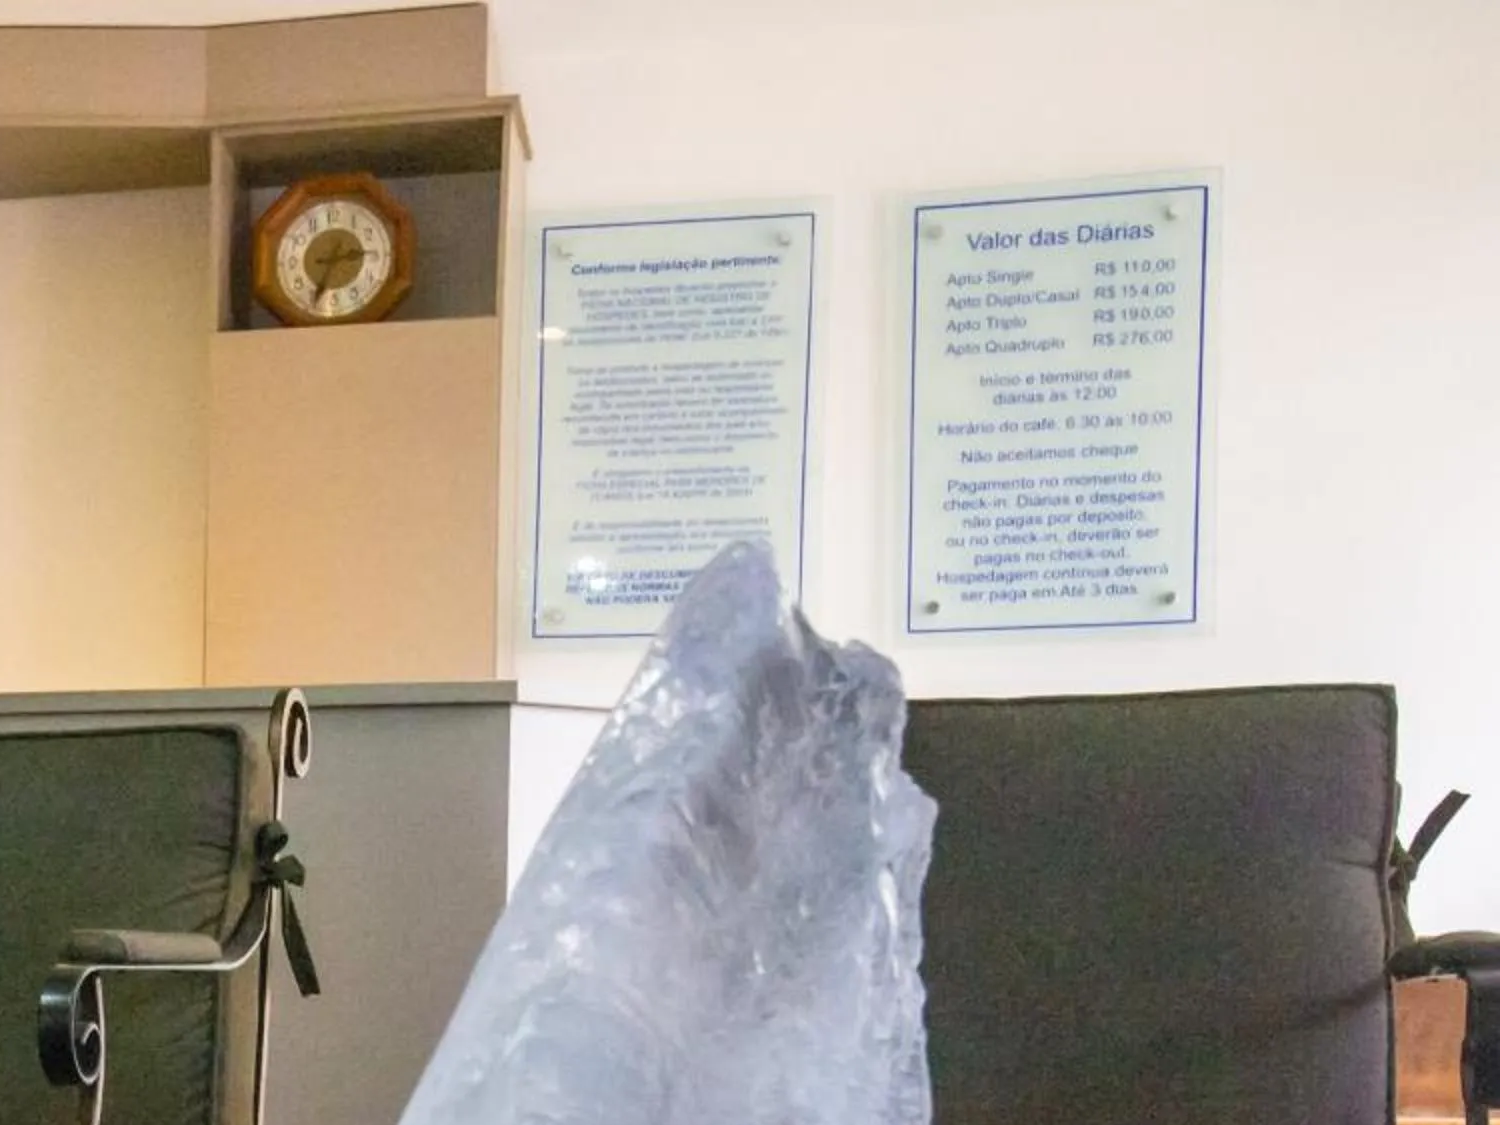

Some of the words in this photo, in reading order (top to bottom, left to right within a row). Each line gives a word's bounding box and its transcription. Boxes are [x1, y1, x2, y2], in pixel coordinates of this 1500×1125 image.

[966, 231, 1023, 251] Valor
[1029, 228, 1069, 246] das
[1077, 223, 1154, 244] Diárias
[571, 261, 636, 276] Conforme
[639, 257, 706, 276] legislação
[947, 272, 982, 287] Apto
[986, 269, 1035, 285] Single
[1095, 261, 1116, 276] R$
[947, 296, 982, 311] Apto
[1094, 285, 1115, 300] R$
[946, 320, 981, 334] Apto
[986, 316, 1027, 333] Triplo
[1093, 309, 1115, 324] R$
[945, 343, 980, 357] Apto
[1093, 333, 1115, 347] R$
[1025, 375, 1035, 385] e
[1103, 367, 1131, 381] das
[937, 421, 994, 436] Horário
[999, 420, 1018, 433] do
[961, 448, 993, 463] Não
[997, 447, 1075, 462] aceitamos
[1081, 443, 1138, 460] cheque
[947, 479, 1035, 495] Pagamento
[1039, 477, 1059, 488] no
[1063, 472, 1137, 486] momento
[1141, 470, 1162, 483] do
[1075, 494, 1085, 505] e
[1089, 489, 1165, 506] despesas
[962, 516, 990, 530] não
[995, 515, 1043, 531] pagas
[1047, 513, 1072, 527] por
[946, 537, 965, 549] ou
[969, 536, 990, 547] no
[1067, 527, 1130, 543] deverão
[1136, 527, 1160, 539] ser
[974, 552, 1021, 568] pagas
[1025, 551, 1045, 562] no
[937, 568, 1039, 586] Hospedagem
[960, 590, 983, 602] ser
[988, 588, 1027, 604] paga
[1031, 588, 1057, 600] em
[1059, 584, 1086, 598] Até
[1091, 583, 1101, 597] 3
